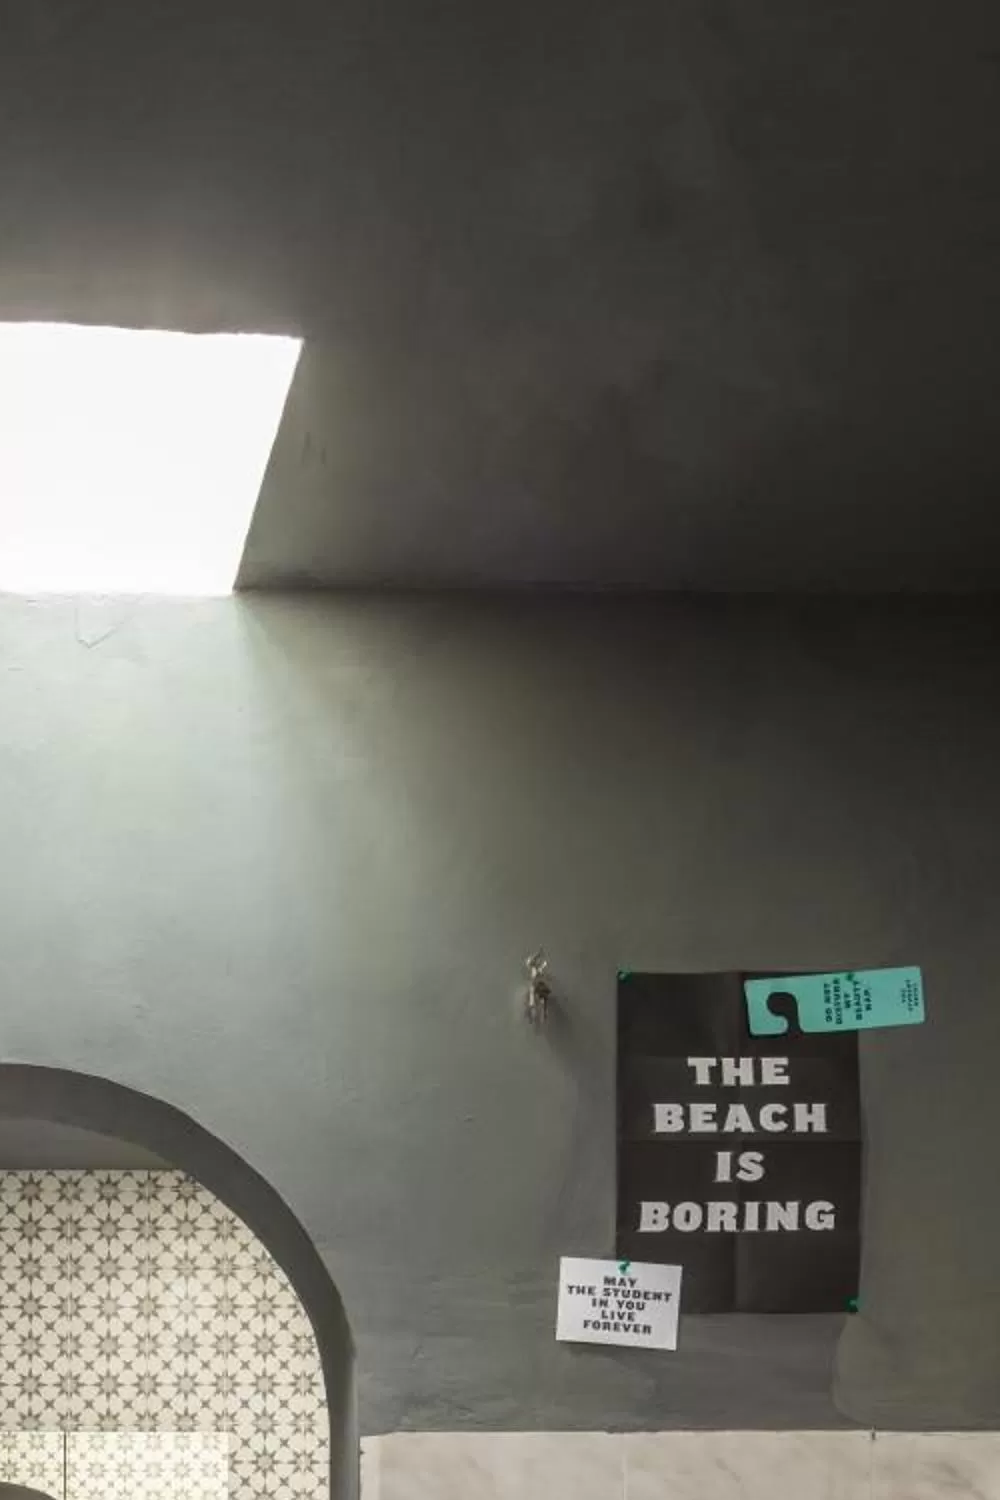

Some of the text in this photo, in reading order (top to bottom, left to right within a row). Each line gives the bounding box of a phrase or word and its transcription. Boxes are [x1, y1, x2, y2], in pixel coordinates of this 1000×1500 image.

[687, 1056, 790, 1085] THE
[652, 1103, 829, 1133] BEACH
[714, 1151, 766, 1183] IS
[637, 1200, 836, 1232] BORING
[603, 1276, 637, 1287] MAY
[567, 1285, 672, 1302] THE STUDENT
[591, 1298, 646, 1311] IN YOU
[601, 1310, 637, 1321] LIVE
[583, 1320, 652, 1334] FOREVER
